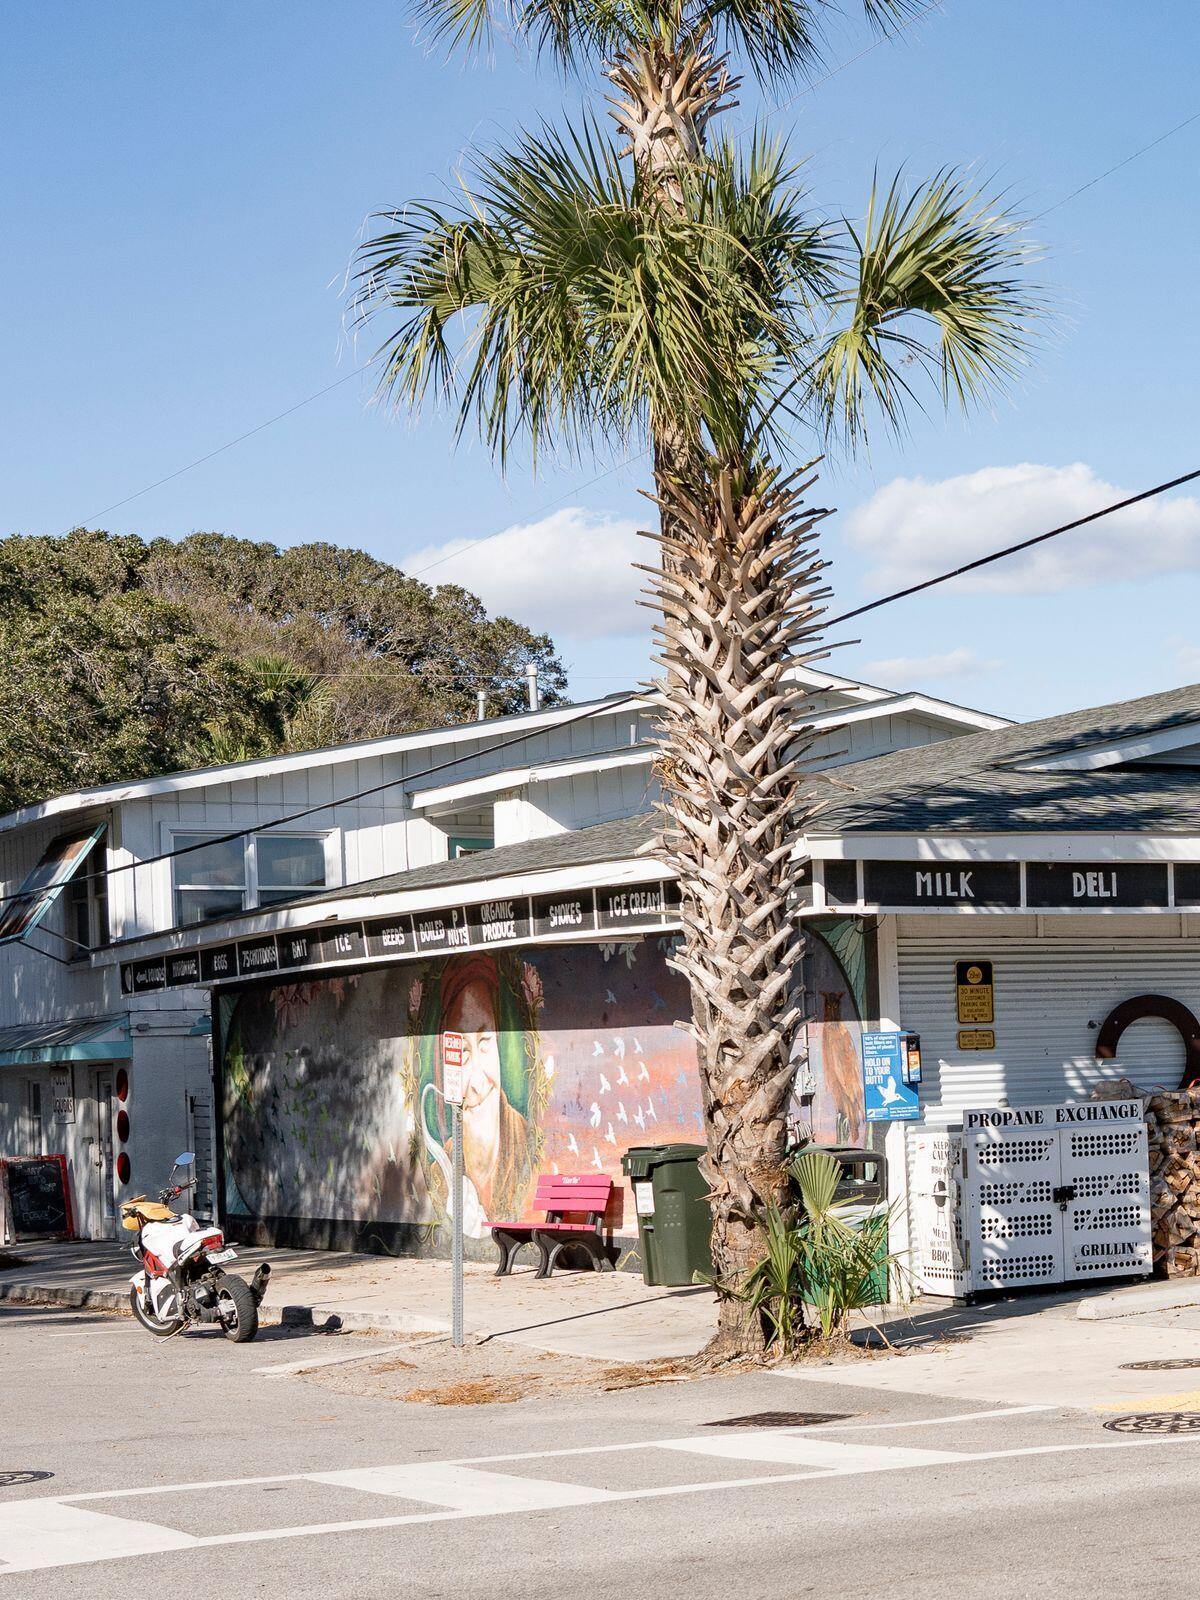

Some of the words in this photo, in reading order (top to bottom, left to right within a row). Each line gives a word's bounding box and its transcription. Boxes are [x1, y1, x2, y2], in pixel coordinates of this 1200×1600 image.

[915, 871, 975, 898] MILK
[1072, 871, 1117, 897] DELI
[480, 901, 514, 923] ORGANIC
[549, 902, 583, 928] SMOKES
[608, 894, 629, 918] ICE
[629, 892, 662, 915] CREAM
[382, 926, 406, 947] BEERS
[419, 919, 445, 943] BOILED
[447, 923, 468, 946] NUTS
[482, 920, 517, 943] PRODUCE
[291, 938, 307, 959] BAIT
[335, 933, 352, 953] ICE
[213, 953, 228, 971] EGGS
[864, 1057, 880, 1067] HOLD
[881, 1057, 891, 1066] ON
[865, 1066, 874, 1076] TO
[874, 1066, 891, 1075] YOUR
[968, 1110, 1044, 1128] PROPANE
[1055, 1103, 1139, 1123] EXCHANGE
[931, 1249, 950, 1263] BBQ!
[1080, 1242, 1138, 1257] GRILLIN'
